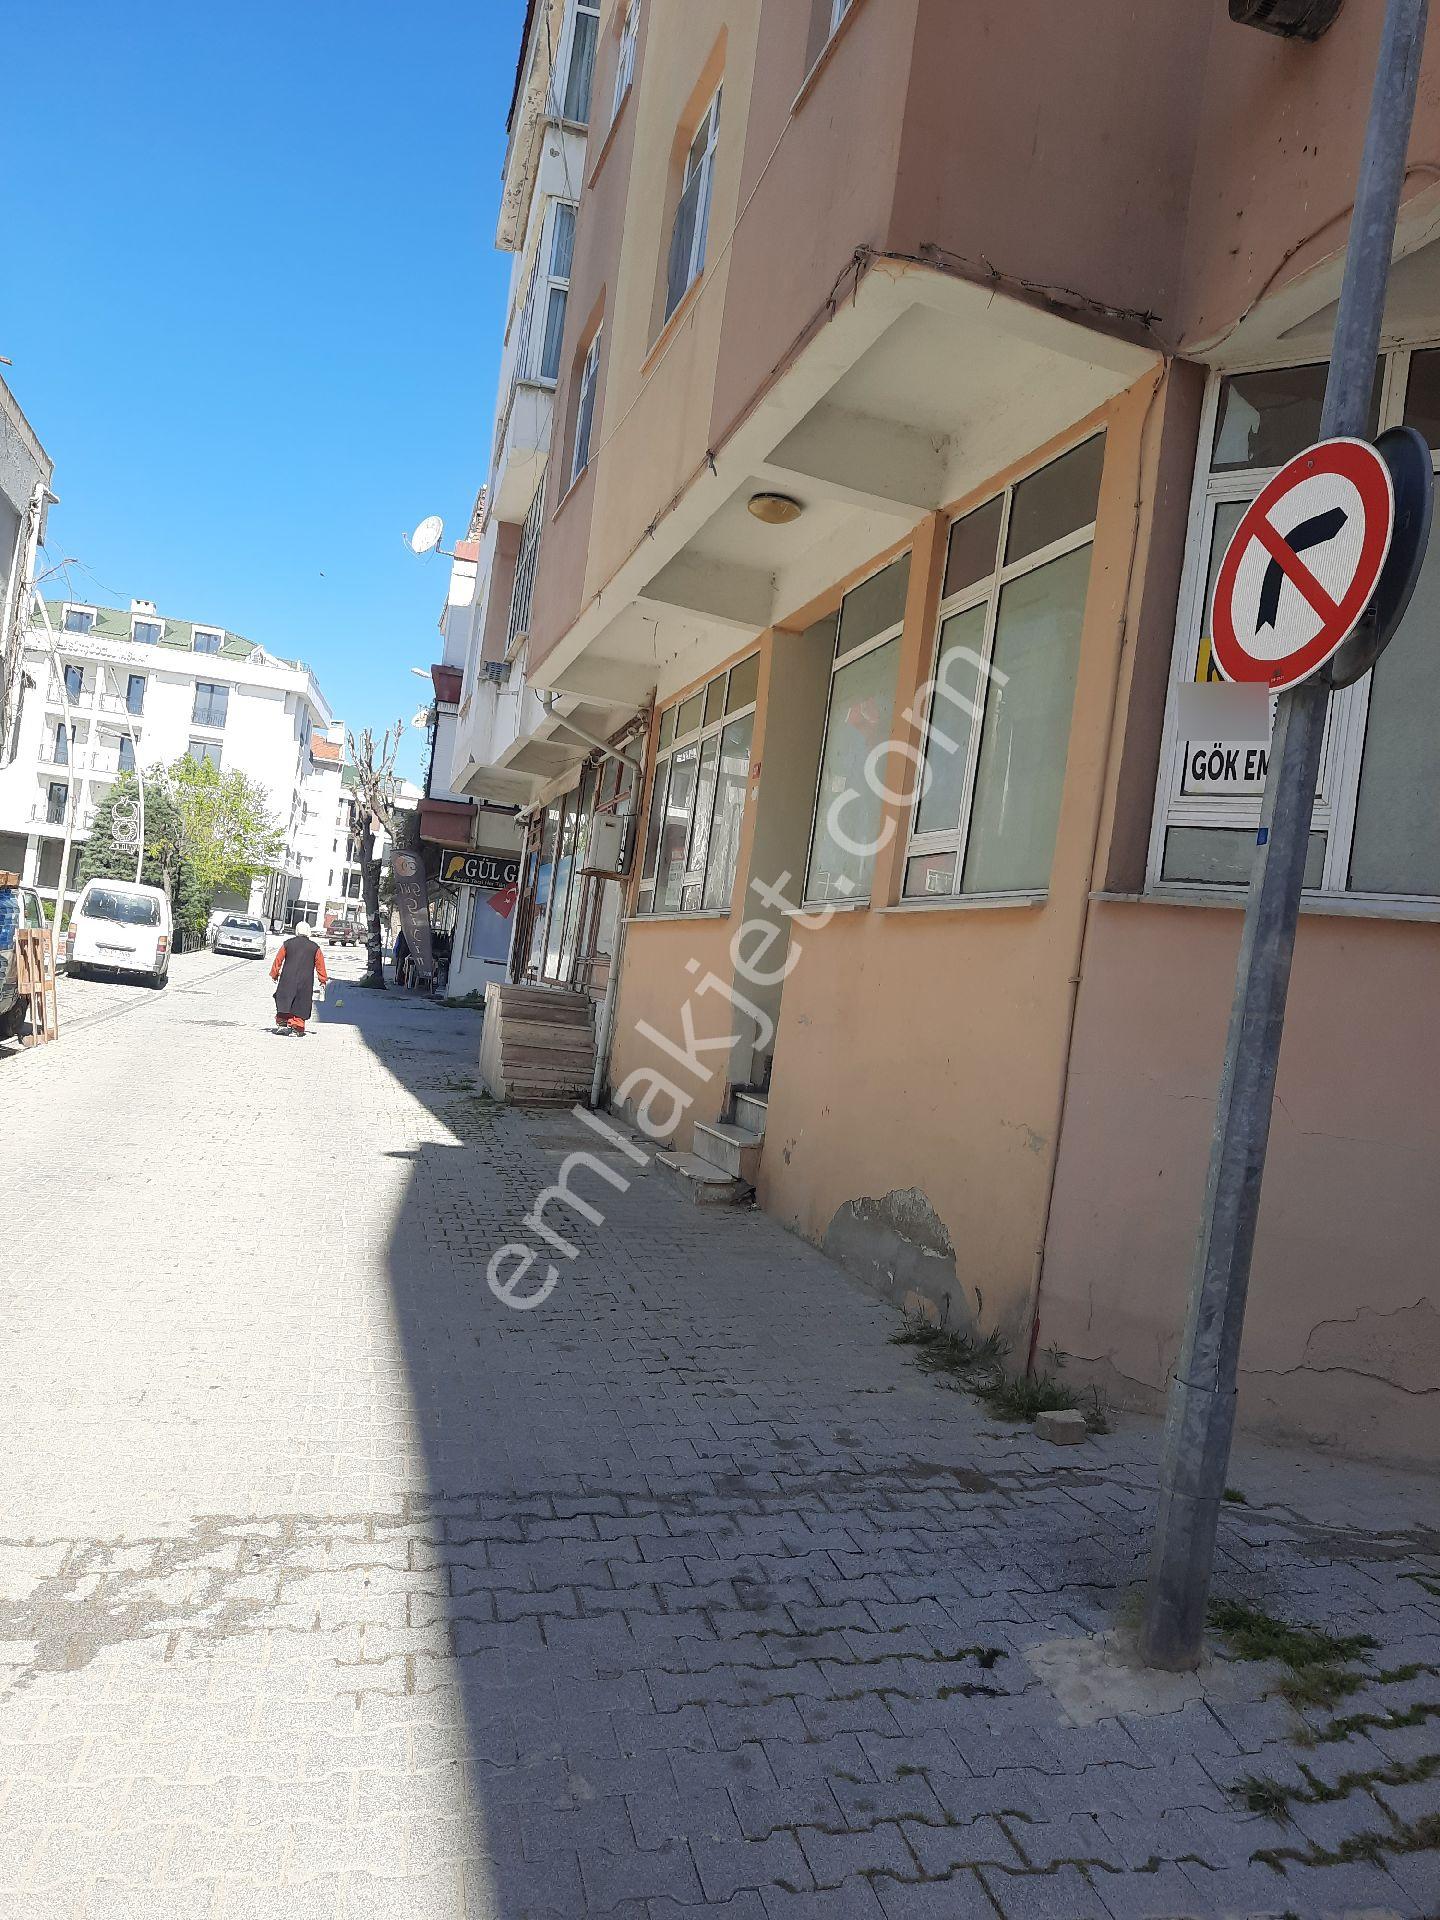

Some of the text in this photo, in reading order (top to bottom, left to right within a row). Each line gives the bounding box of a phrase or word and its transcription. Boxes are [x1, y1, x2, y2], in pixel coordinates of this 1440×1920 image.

[1191, 742, 1269, 781] GÖK EM
[465, 858, 500, 881] GÜL
